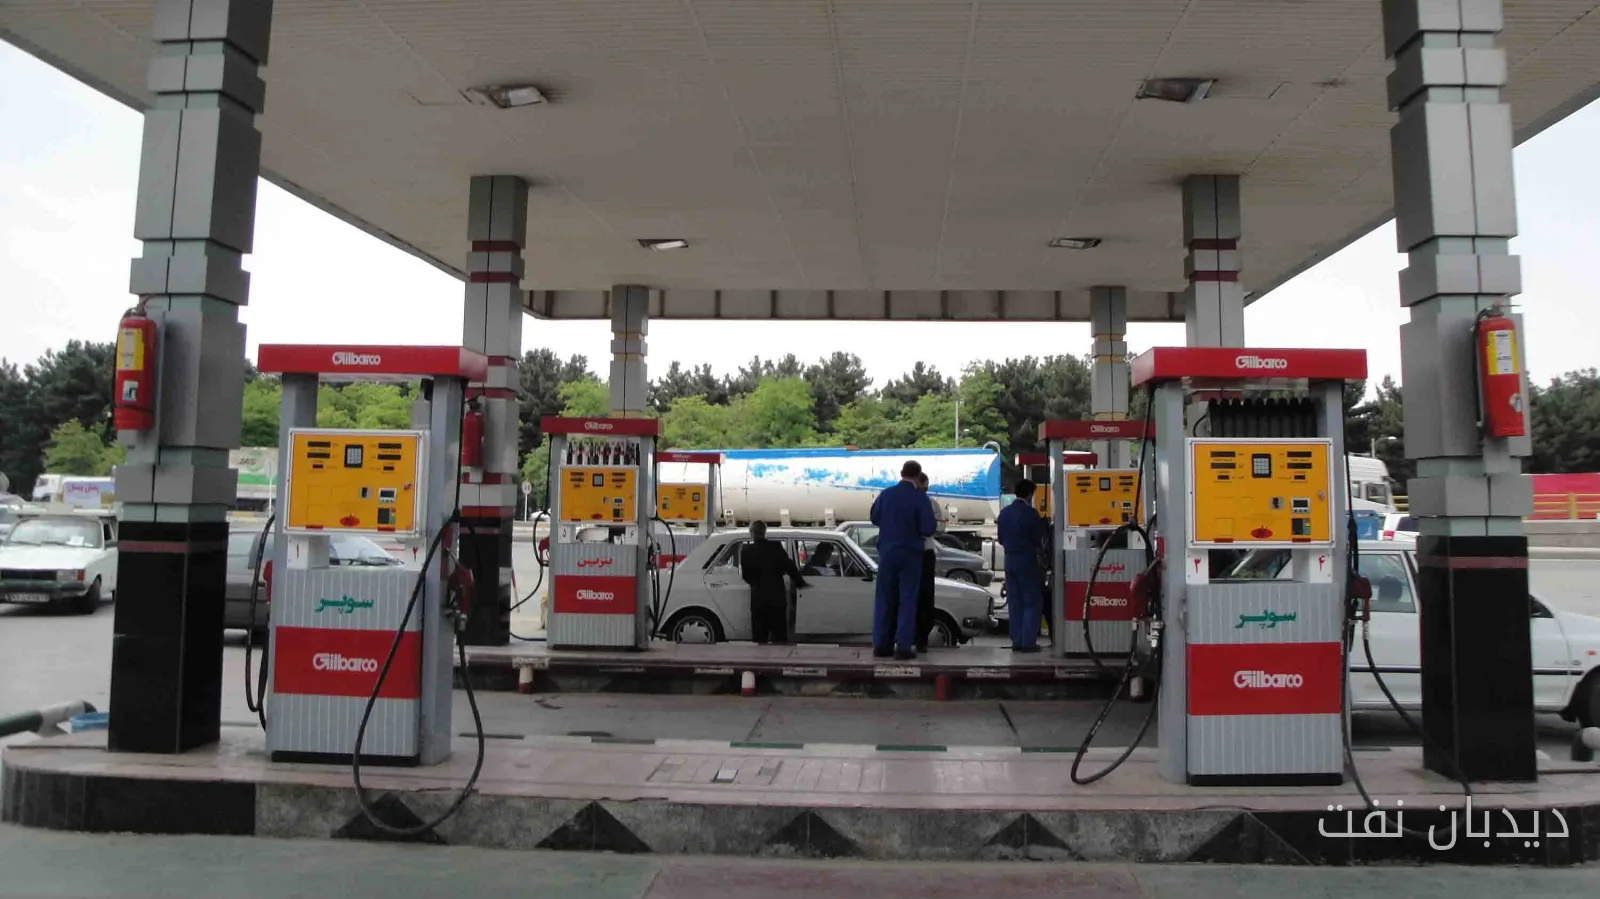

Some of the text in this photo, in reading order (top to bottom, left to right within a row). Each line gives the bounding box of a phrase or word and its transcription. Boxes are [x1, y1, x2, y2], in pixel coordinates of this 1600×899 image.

[332, 351, 381, 366] Gilbarco
[1235, 355, 1288, 369] Gilbarco
[576, 589, 614, 600] Gilbarco
[1090, 596, 1128, 606] Gilbarco
[314, 594, 374, 614] سوپر
[1234, 609, 1297, 630] سوپر
[312, 652, 378, 672] Gilbarco
[1233, 670, 1304, 688] Gilbarco
